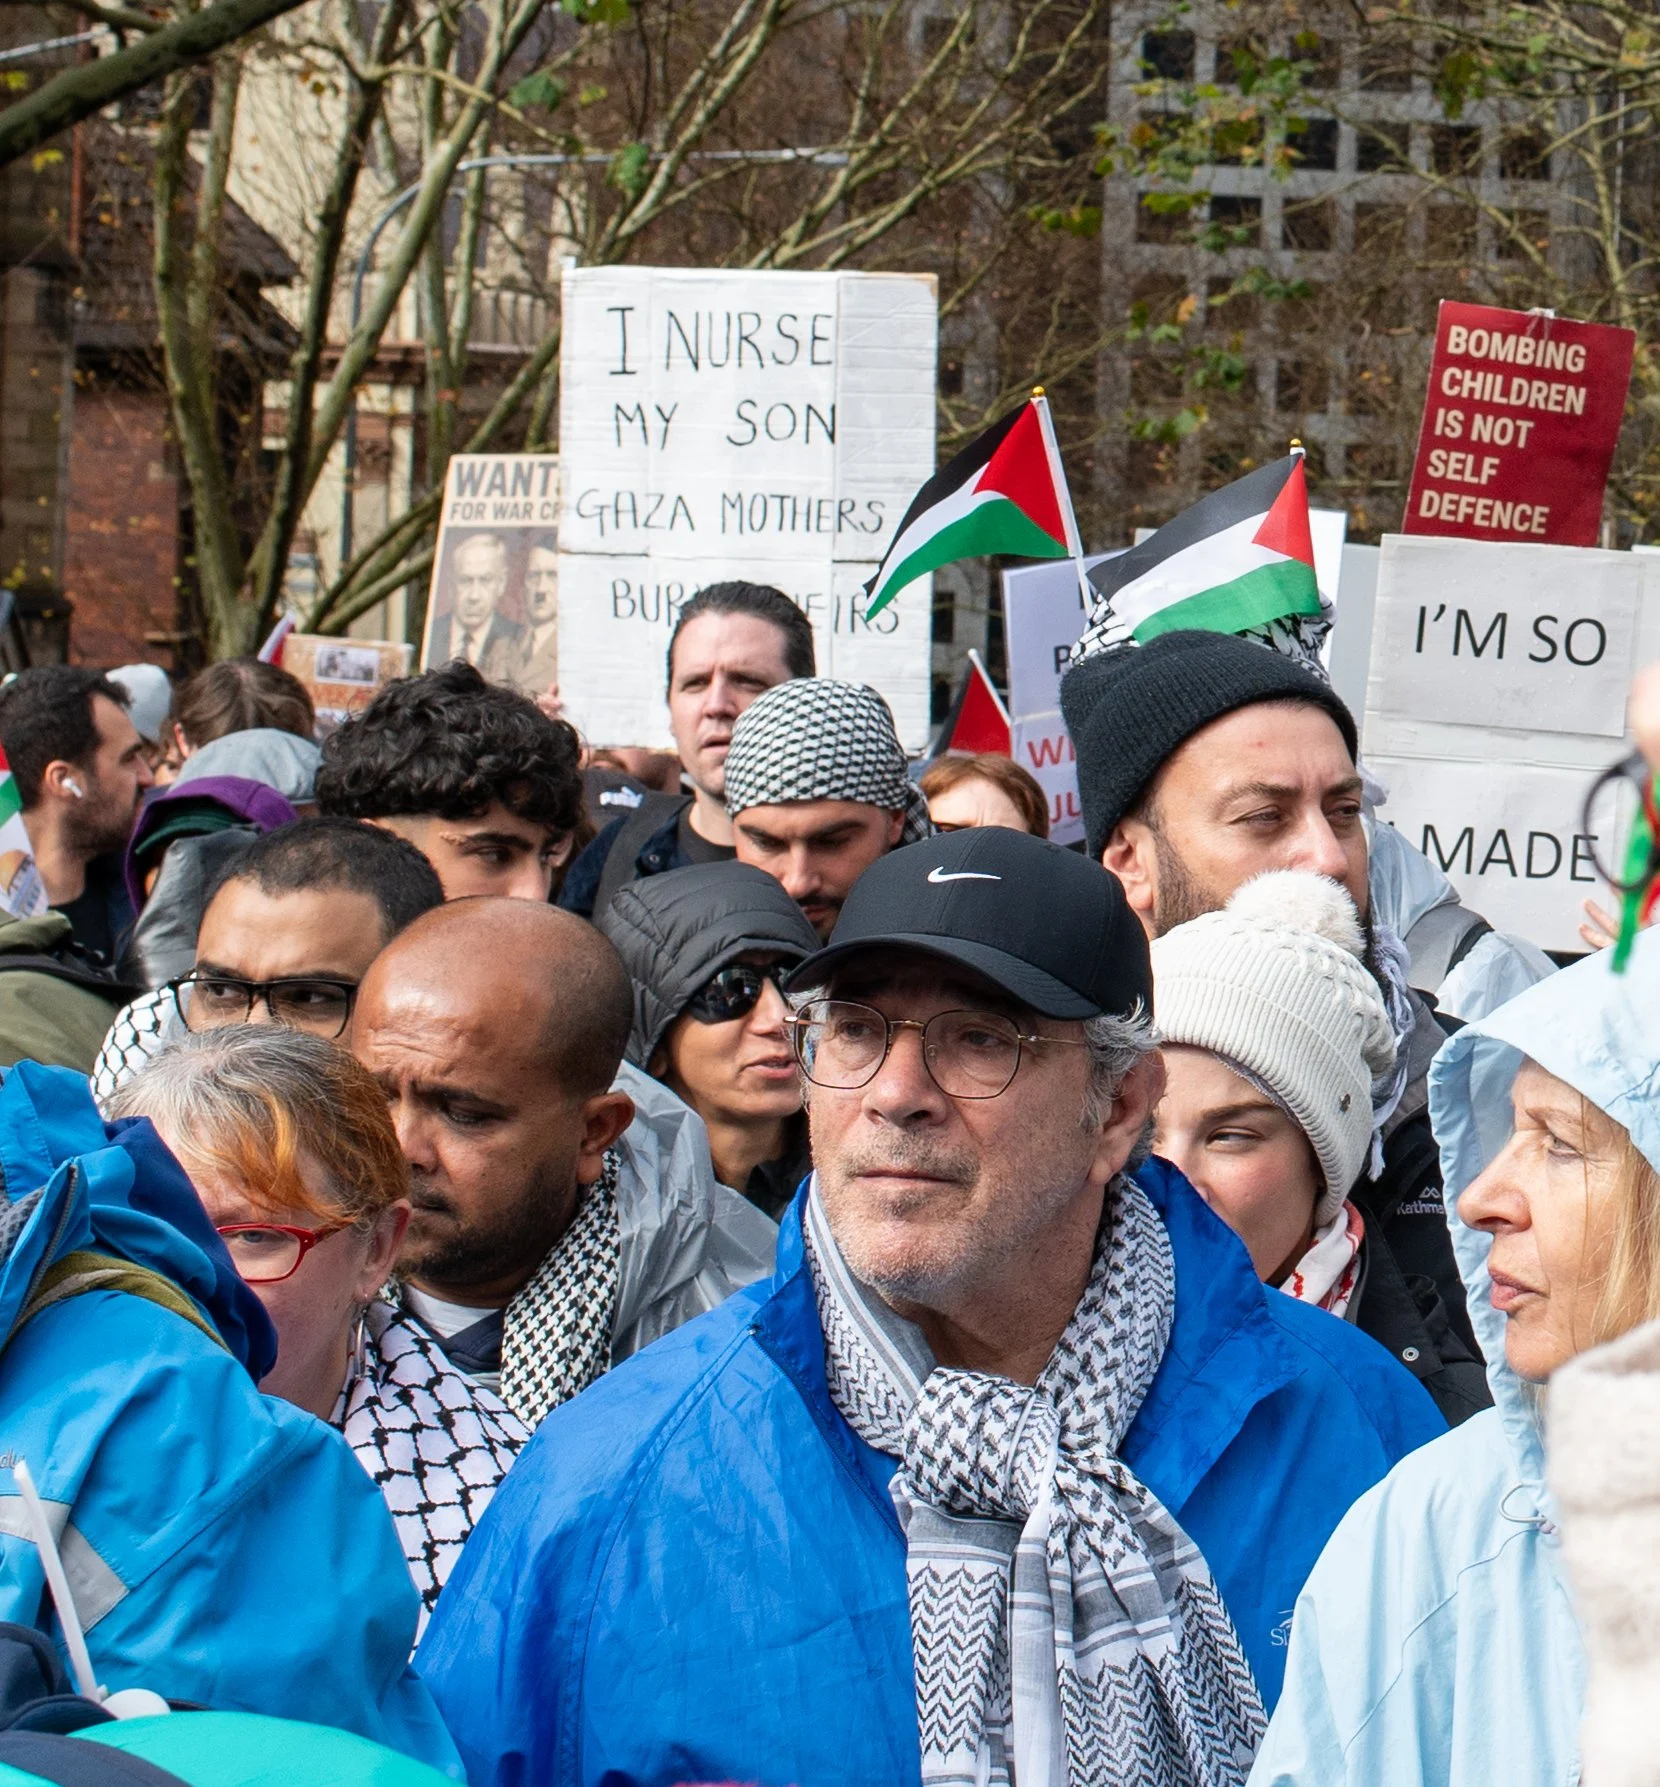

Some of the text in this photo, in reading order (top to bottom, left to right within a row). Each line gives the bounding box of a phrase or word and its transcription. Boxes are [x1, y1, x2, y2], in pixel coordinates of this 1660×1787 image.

[607, 306, 834, 375] I NURSE
[1447, 325, 1587, 374] BOMBING
[1441, 367, 1587, 415] CHILDREN
[614, 399, 836, 450] MY SON
[1434, 408, 1535, 449] IS NOT
[456, 462, 560, 497] WANT
[1427, 449, 1500, 485] SELF
[449, 502, 487, 521] FOR
[492, 502, 534, 521] WAR
[575, 488, 887, 537] GAZA MOTHERS
[1419, 490, 1550, 535] DEFENCE
[611, 579, 702, 629] BUR
[1415, 603, 1608, 666] I'M SO
[1422, 824, 1599, 882] MADE
